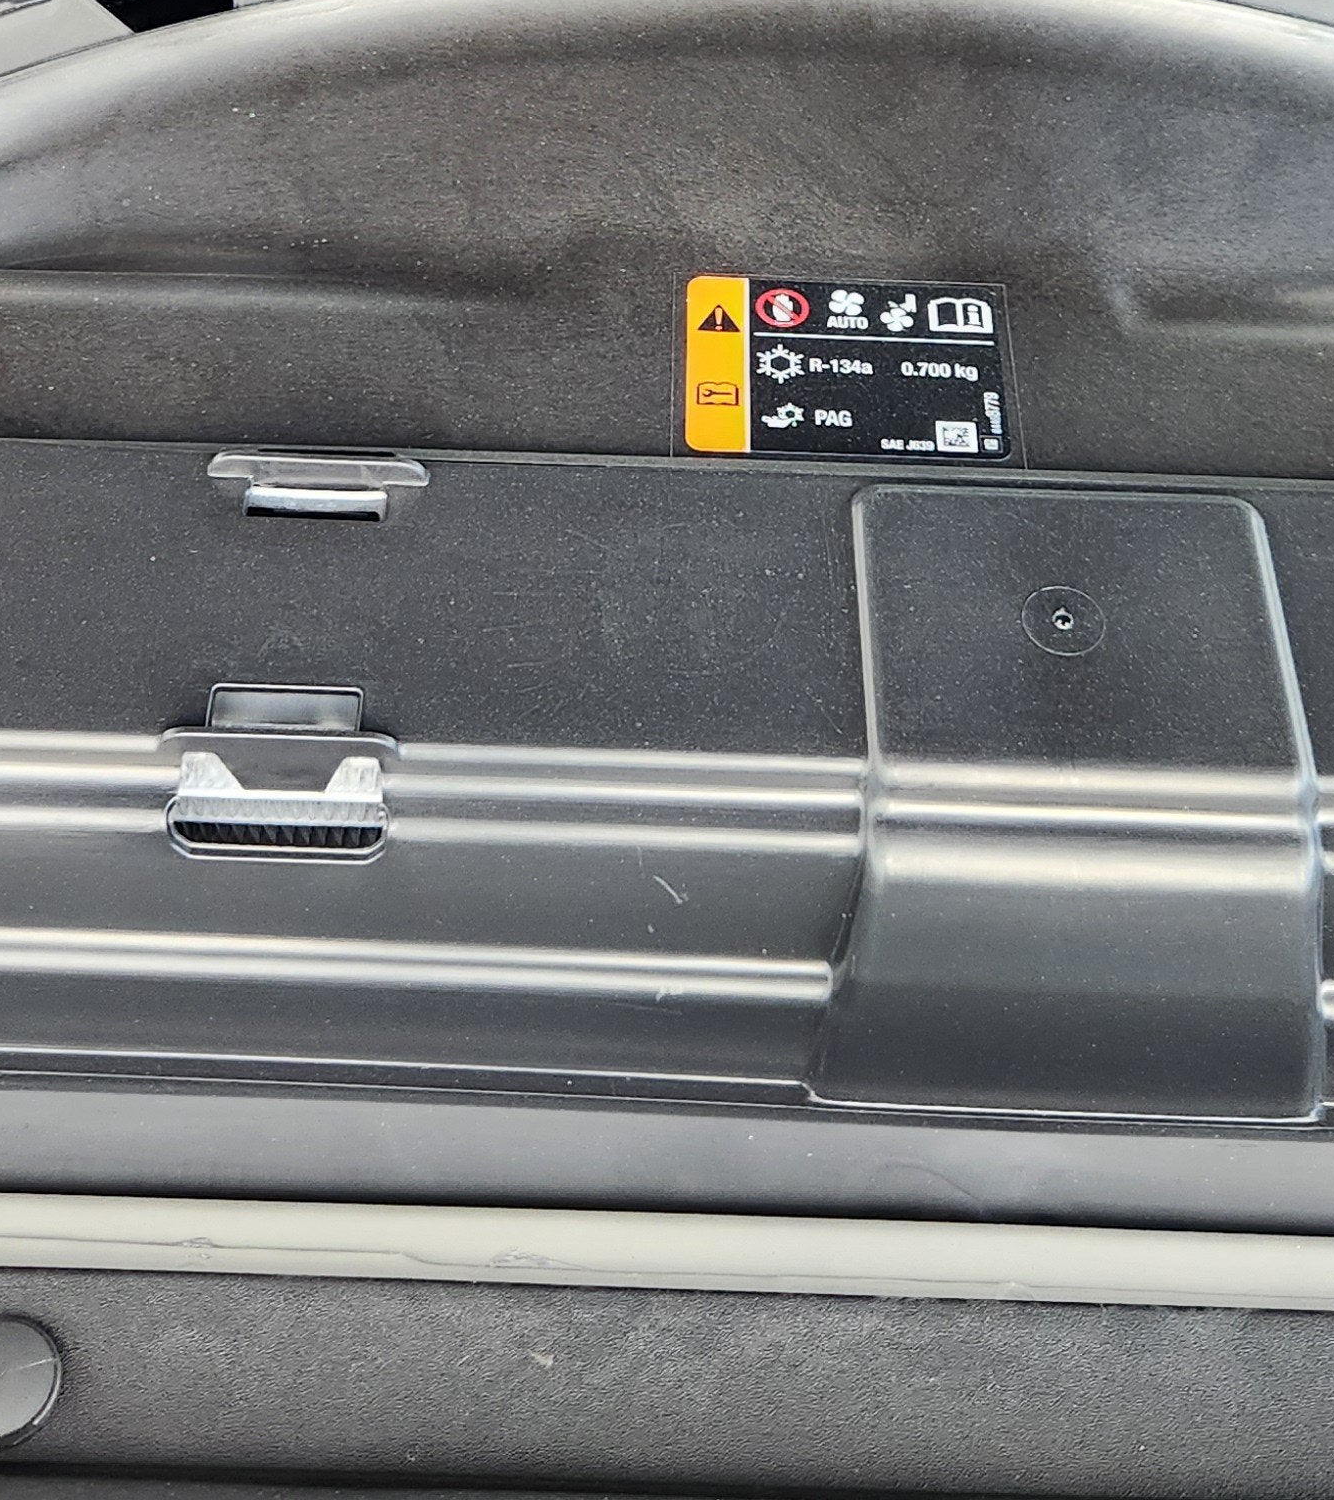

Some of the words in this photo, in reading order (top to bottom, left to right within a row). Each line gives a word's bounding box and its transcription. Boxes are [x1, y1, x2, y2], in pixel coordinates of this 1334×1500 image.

[827, 316, 869, 330] AUTO
[808, 357, 874, 375] R-134a
[900, 361, 952, 379] 0.700
[954, 363, 979, 382] kg
[814, 409, 853, 427] PAG
[880, 438, 904, 450] SAE
